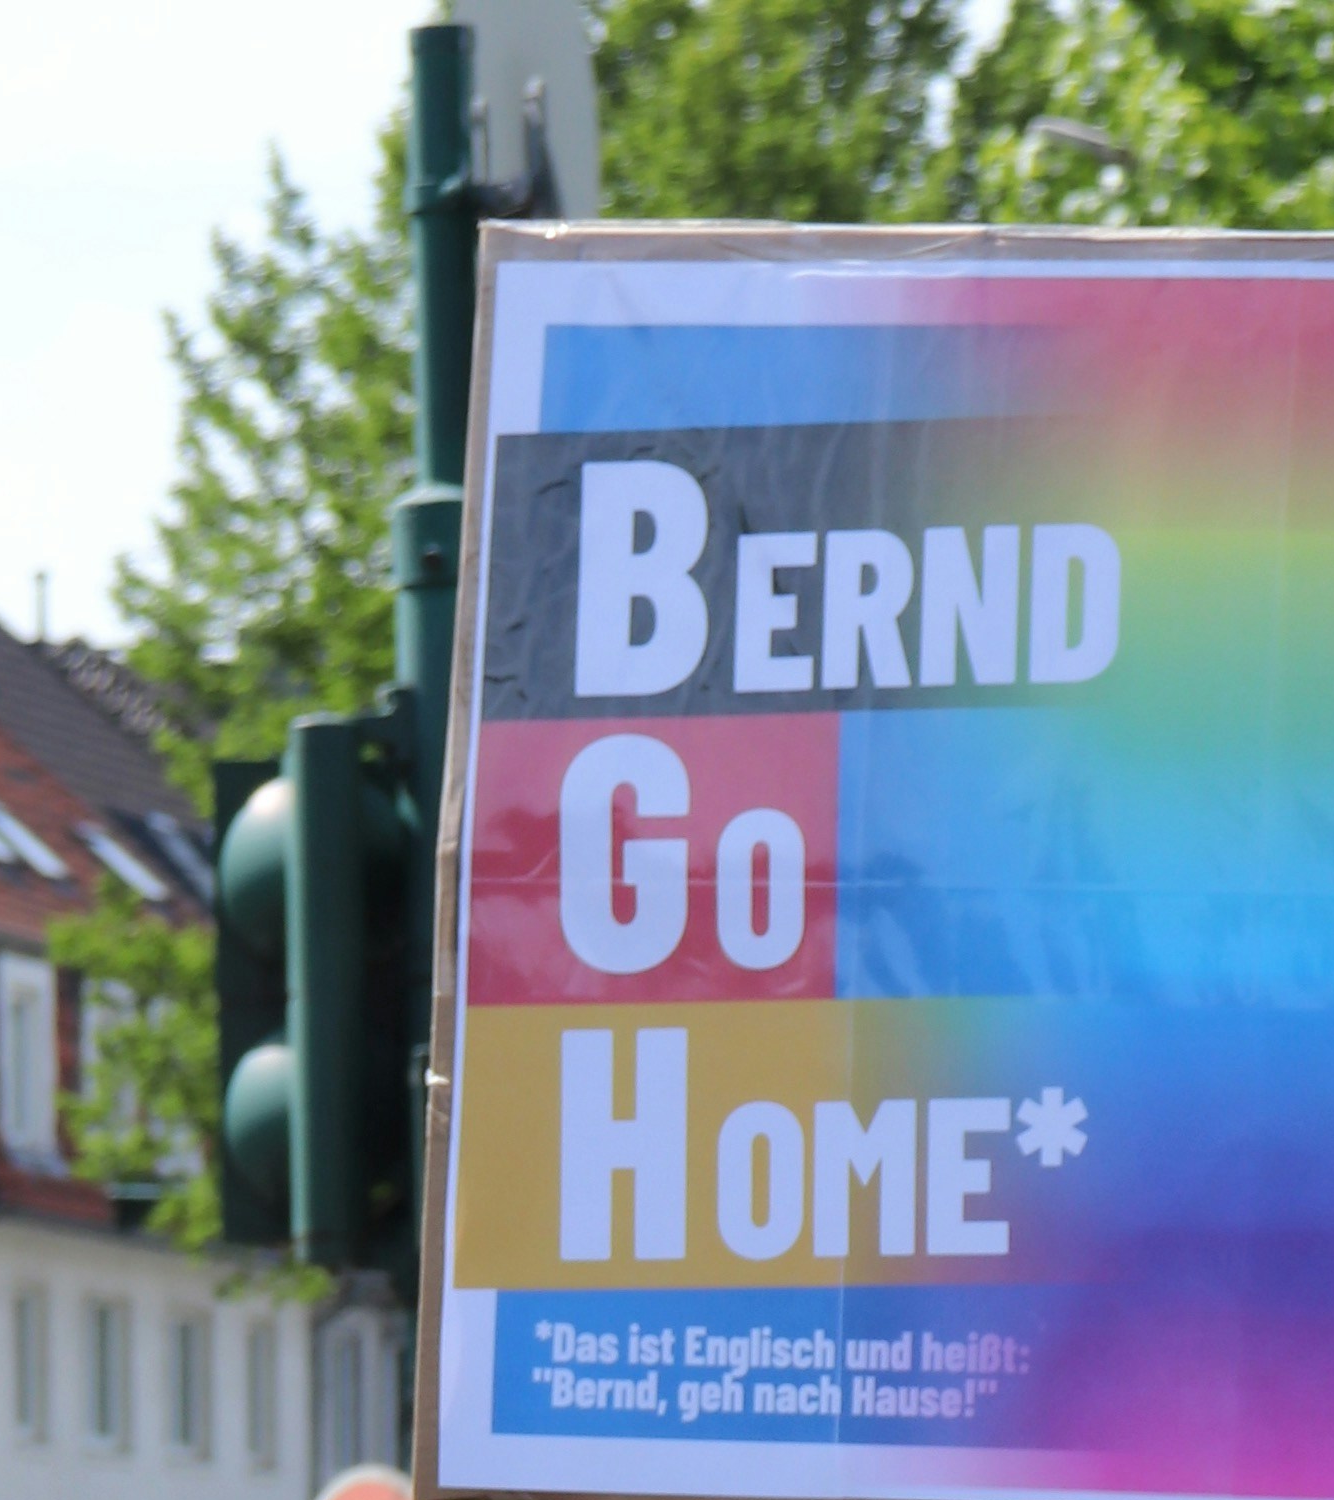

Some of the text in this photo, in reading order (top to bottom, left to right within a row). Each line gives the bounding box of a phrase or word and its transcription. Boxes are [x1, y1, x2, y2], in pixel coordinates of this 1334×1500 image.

[575, 458, 1123, 698] BERND
[559, 733, 806, 975] GO
[532, 1367, 997, 1422] "Bernd, geh nach Hause!"
[628, 1323, 675, 1365] ist
[685, 1325, 835, 1378] Englisch
[845, 1331, 912, 1371] und
[921, 1332, 1030, 1374] heißt:
